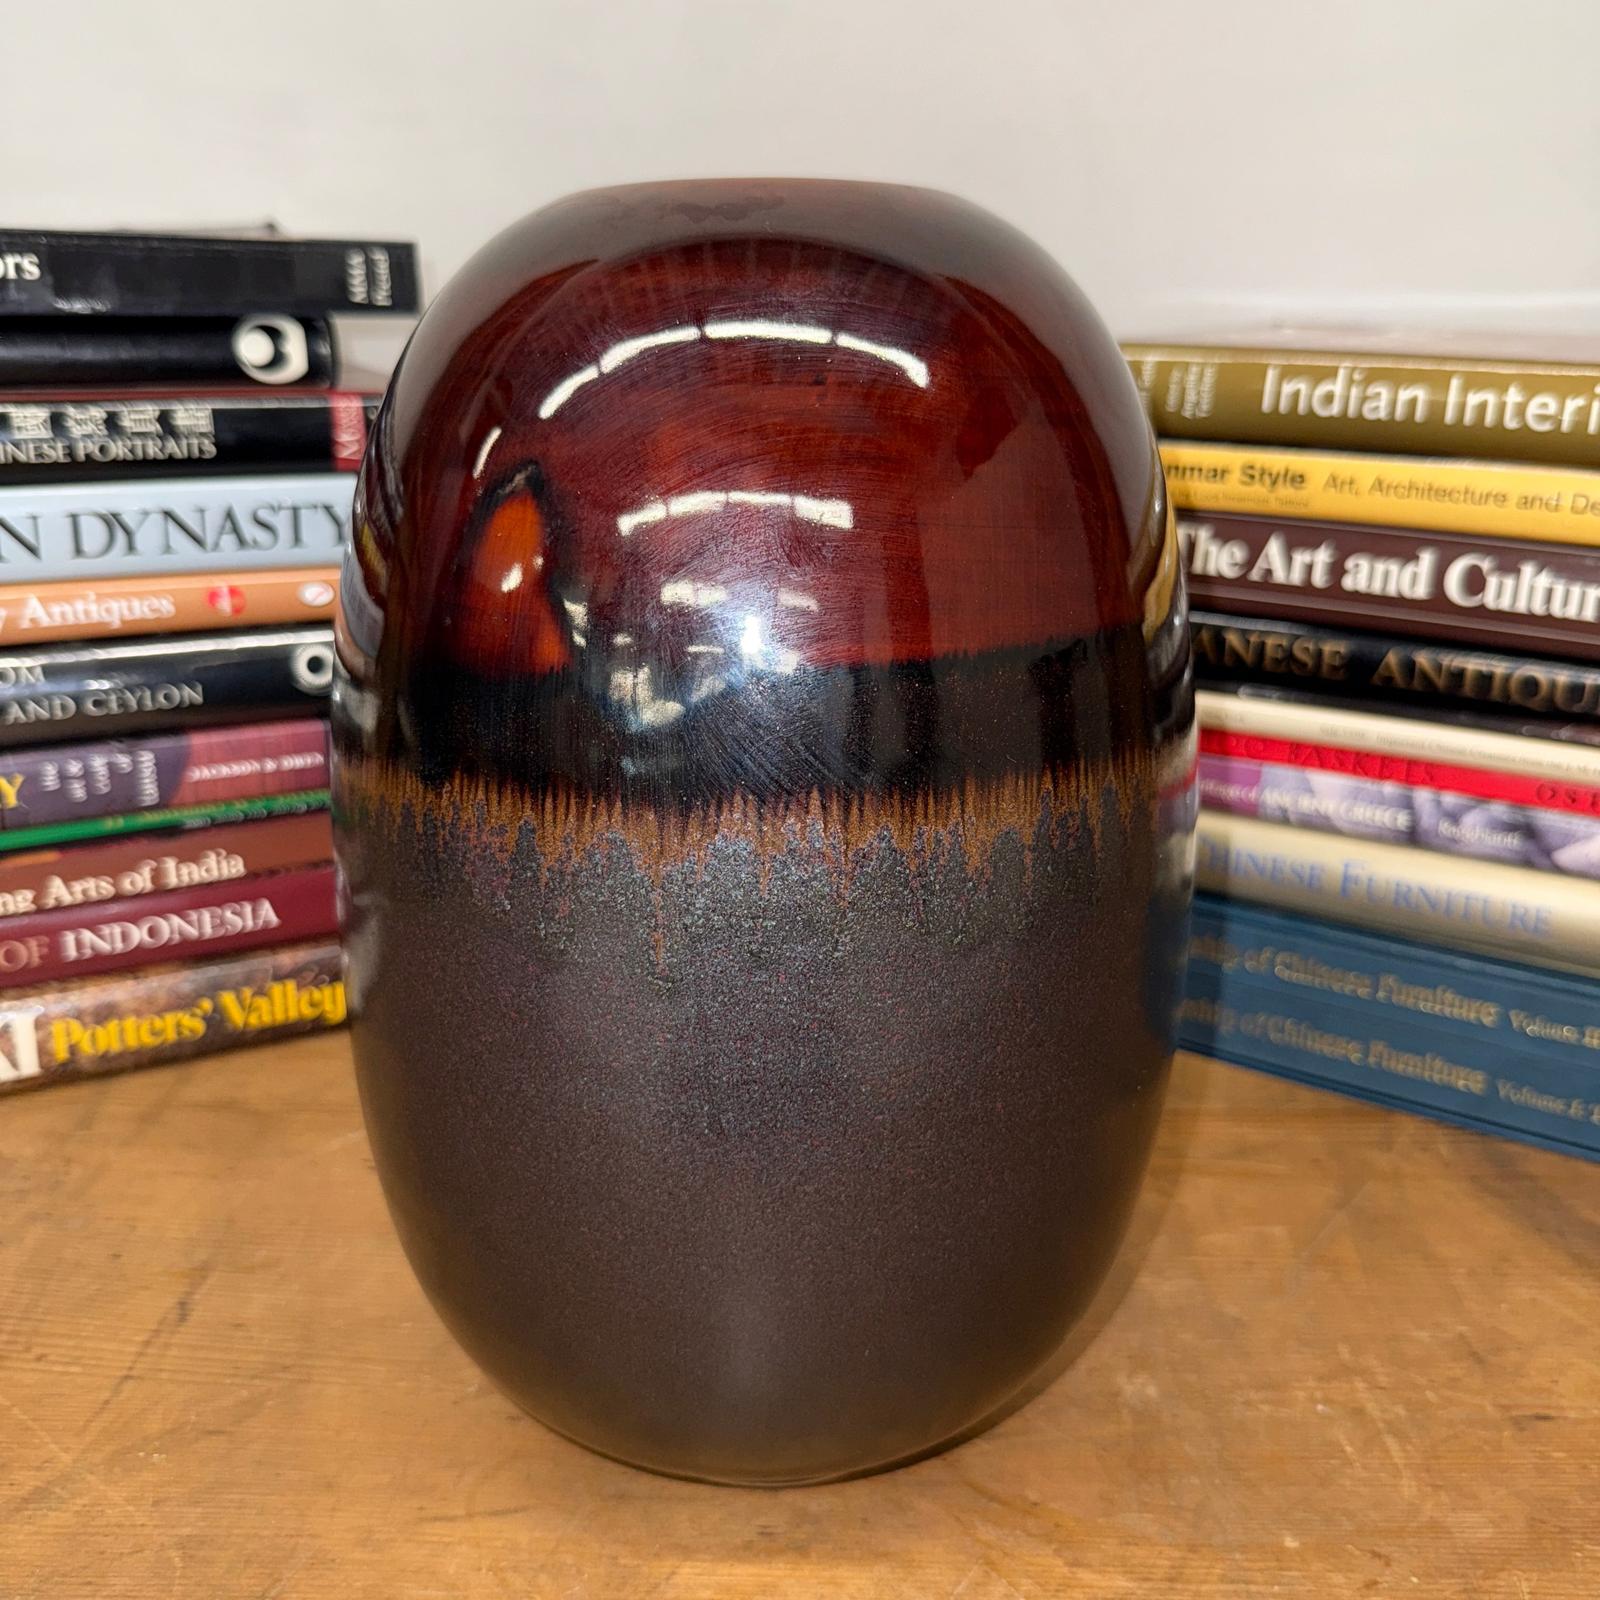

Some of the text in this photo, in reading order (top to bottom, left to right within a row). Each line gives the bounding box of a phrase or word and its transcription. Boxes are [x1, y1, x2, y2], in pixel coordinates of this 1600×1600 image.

[0, 252, 41, 280] rs
[1260, 363, 1431, 423] Indian
[1443, 373, 1600, 435] Interi
[73, 435, 217, 463] PORTRAITS
[1239, 463, 1308, 491] Style
[1322, 470, 1361, 495] Art,
[1368, 474, 1508, 509] Architecture
[1514, 490, 1562, 513] and
[1568, 492, 1600, 517] De
[67, 503, 346, 560] DYNASTY
[1176, 521, 1600, 624] The Art and Cultur
[21, 592, 176, 629] Antiques
[1192, 626, 1352, 681] ANESE
[4, 681, 204, 725] AND CEYLON
[0, 773, 24, 809] Y
[39, 874, 116, 910] Arts
[115, 859, 157, 896] of
[155, 847, 247, 890] India
[1339, 858, 1553, 937] FURNITURE
[0, 897, 281, 973] OF INDONESIA
[51, 997, 213, 1064] Potters'
[216, 978, 346, 1032] Valley
[1375, 973, 1502, 1028] Furniture
[1509, 1009, 1580, 1045] Volume
[1367, 1039, 1488, 1096] Furniture
